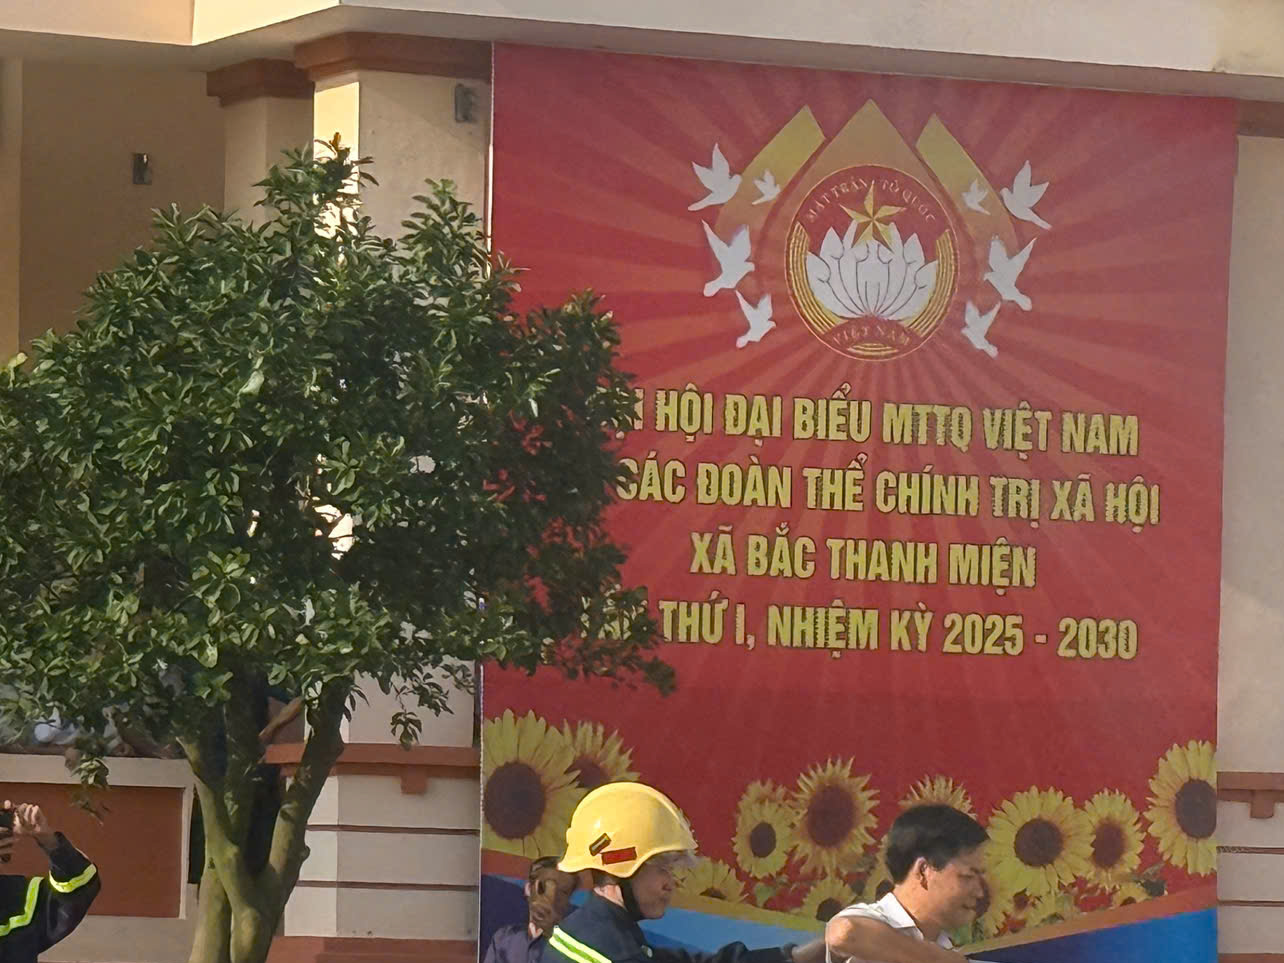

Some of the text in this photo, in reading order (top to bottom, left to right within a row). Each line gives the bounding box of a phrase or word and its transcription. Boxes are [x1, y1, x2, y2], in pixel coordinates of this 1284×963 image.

[655, 383, 713, 443] HỘI
[724, 393, 782, 447] ĐẠI
[793, 382, 872, 444] BIỂU
[882, 402, 973, 452] MTTQ
[982, 400, 1052, 460] VIỆT
[1061, 410, 1138, 457] NAM
[615, 450, 1161, 534] CÁC ĐOÀN THỂ CHÍNH TRỊ XÃ HỘI
[689, 521, 1037, 596] XÃ BẮC THANH MIỆN
[658, 589, 729, 645] THỨ
[735, 603, 756, 650] I,
[767, 599, 879, 660] NHIỆM
[890, 601, 935, 653] KỲ
[942, 612, 1024, 656] 2025
[1034, 633, 1048, 645] -
[1056, 616, 1138, 661] 2030
